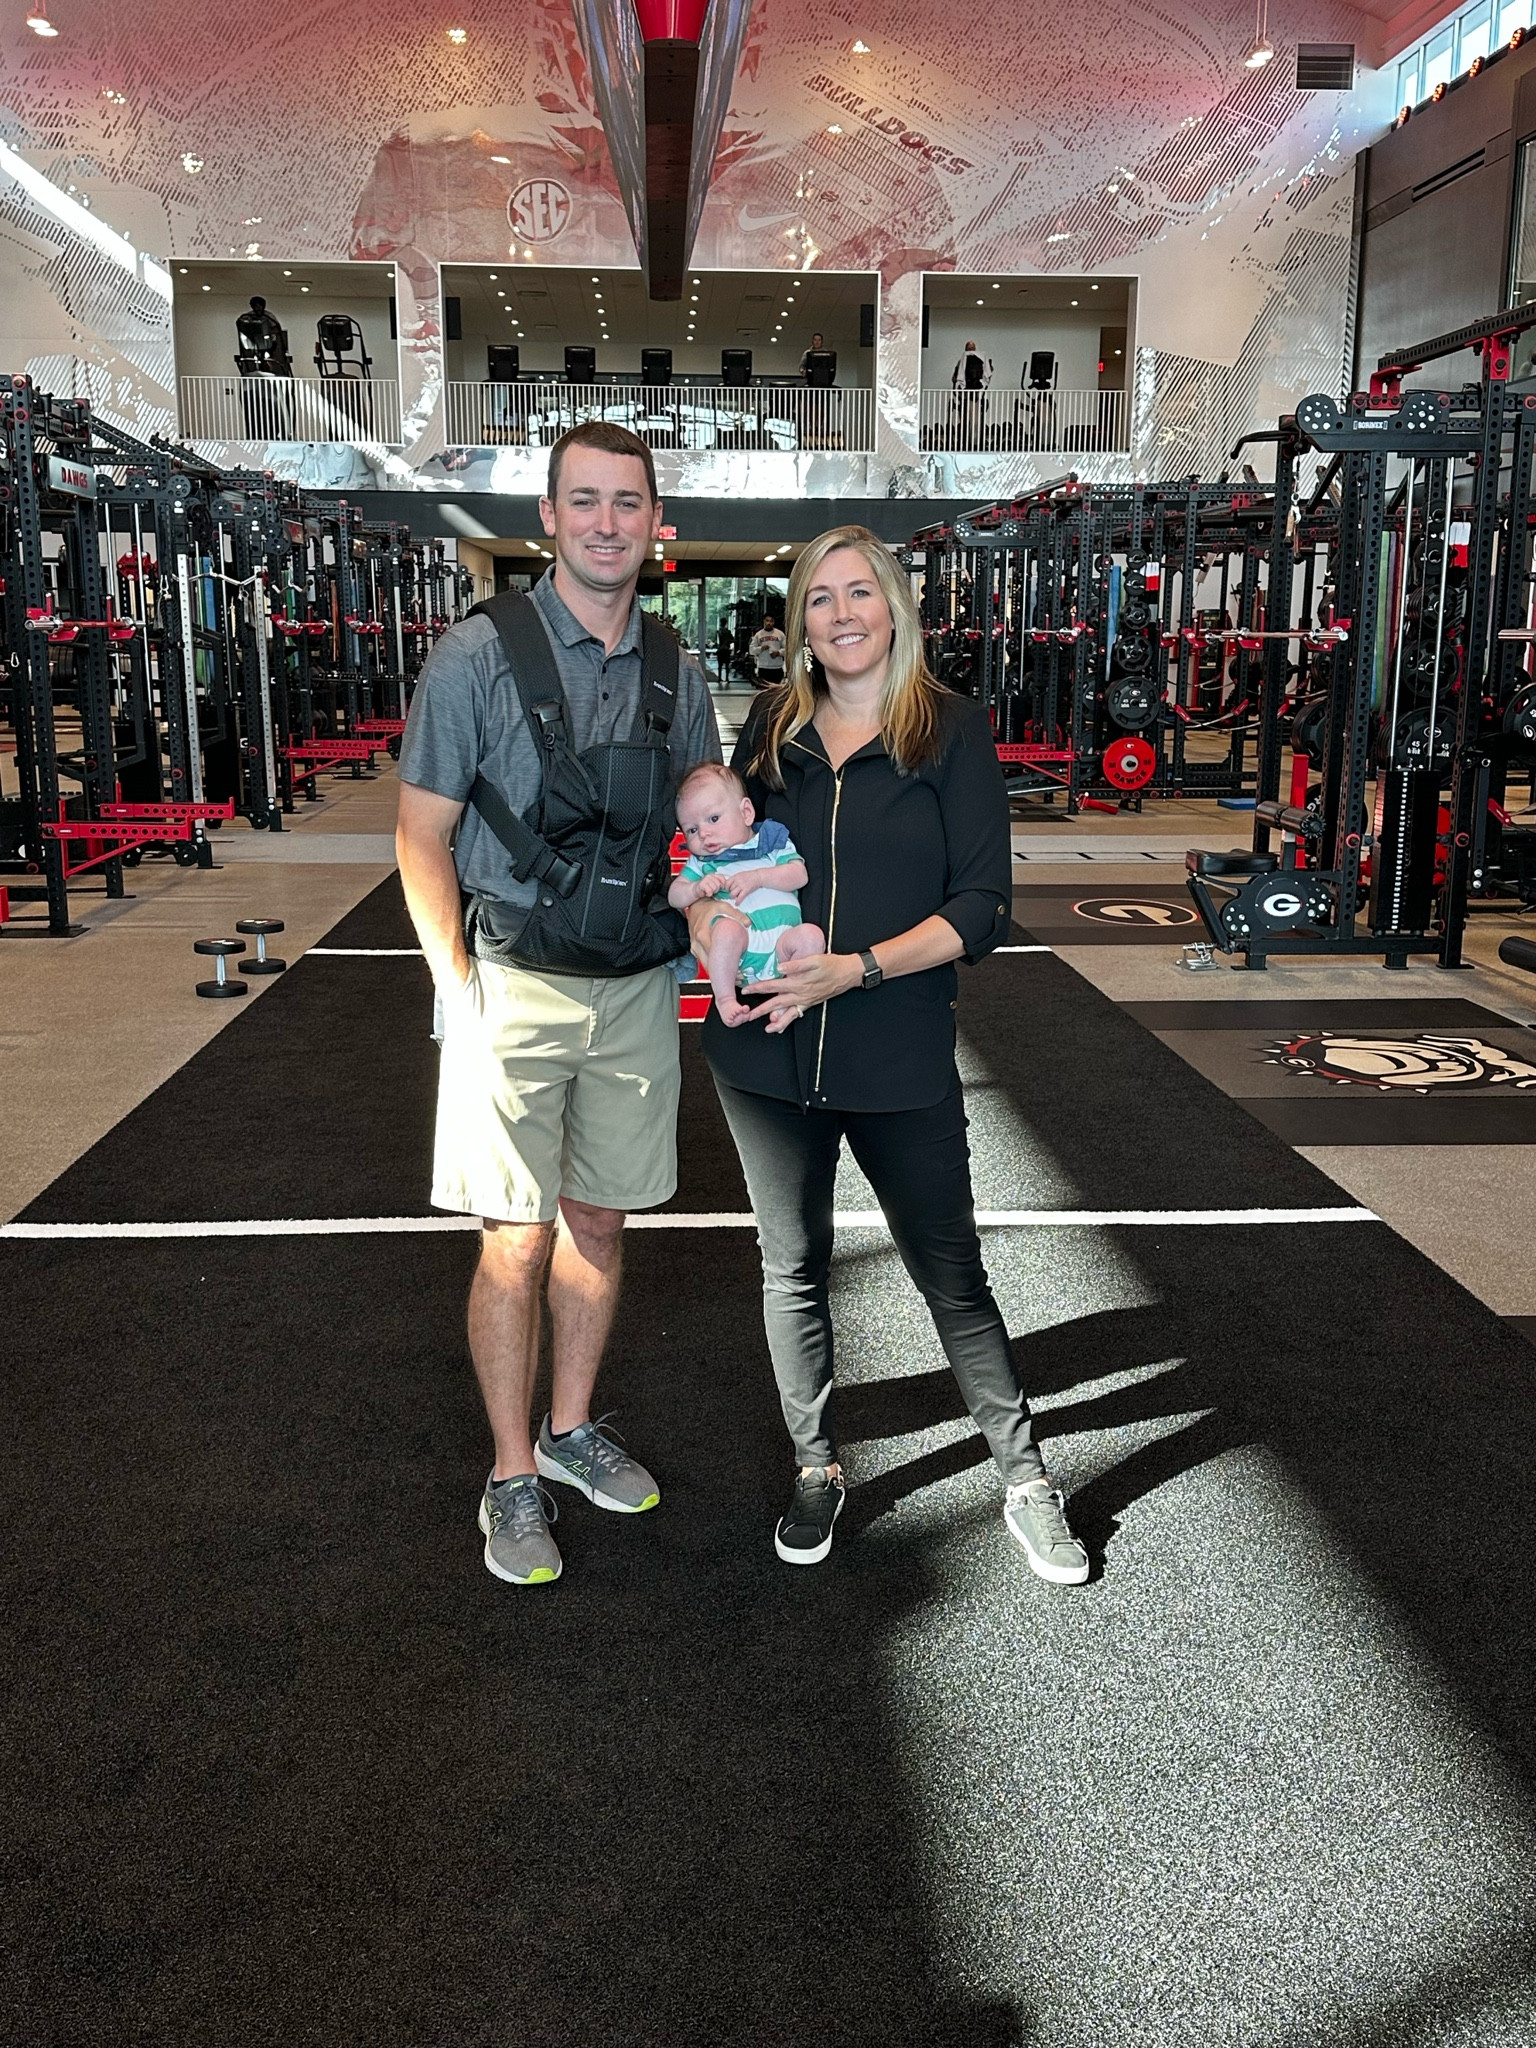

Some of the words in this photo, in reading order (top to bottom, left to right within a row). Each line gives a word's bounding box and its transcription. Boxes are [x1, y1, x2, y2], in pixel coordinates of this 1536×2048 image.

[803, 73, 975, 175] BULLDOGS
[512, 182, 567, 238] SEC
[61, 466, 88, 489] DAWGS
[1114, 769, 1147, 785] DAWGS
[1263, 893, 1301, 917] G
